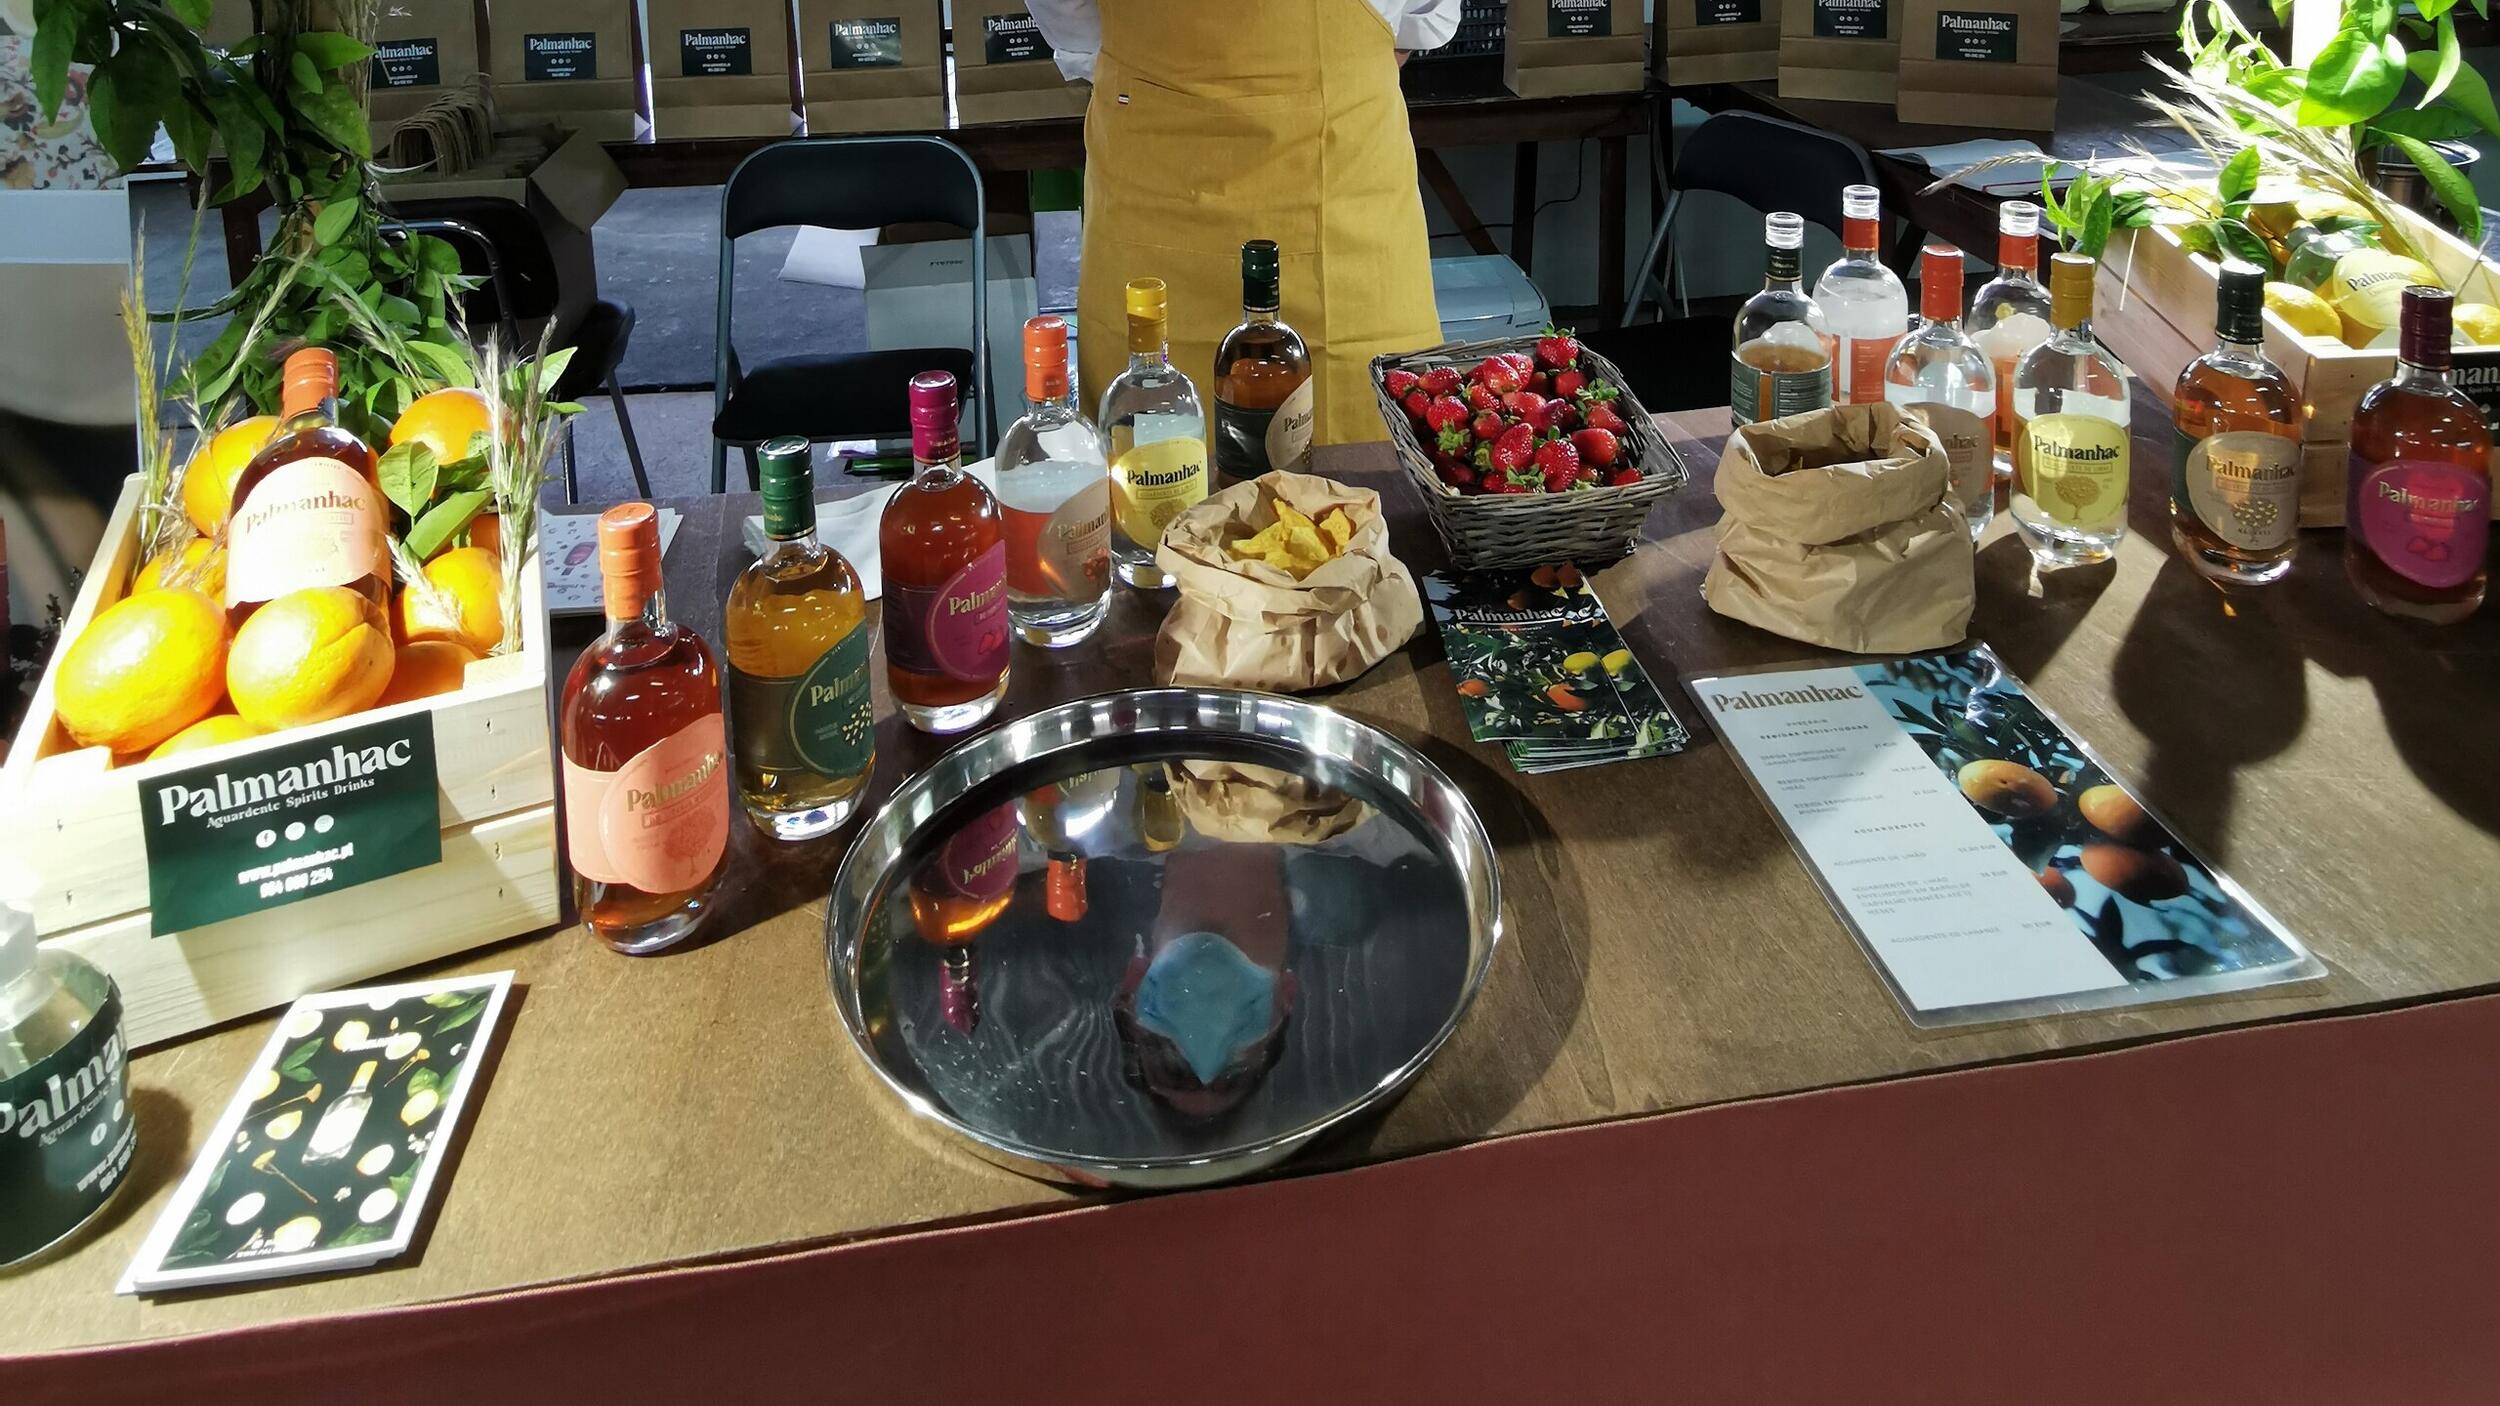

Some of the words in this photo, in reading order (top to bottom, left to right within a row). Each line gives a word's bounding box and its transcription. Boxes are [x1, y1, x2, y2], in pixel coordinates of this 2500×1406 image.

[834, 22, 897, 37] Palmanhac
[1942, 15, 2011, 31] Palmanhac
[529, 37, 592, 51] Palmanhac
[684, 32, 747, 46] Palmanhac
[375, 43, 433, 59] almanhac
[2034, 435, 2120, 461] Palmanhac
[1127, 460, 1202, 486] Palmanhac
[1454, 605, 1566, 622] Palmanhac
[1711, 684, 1864, 712] Palmanhac
[158, 738, 412, 826] Palmanhac
[206, 801, 281, 829] Aguardente
[286, 790, 329, 808] Spirits
[333, 777, 375, 796] Drinks
[1852, 821, 1927, 834] AGUARDENTES
